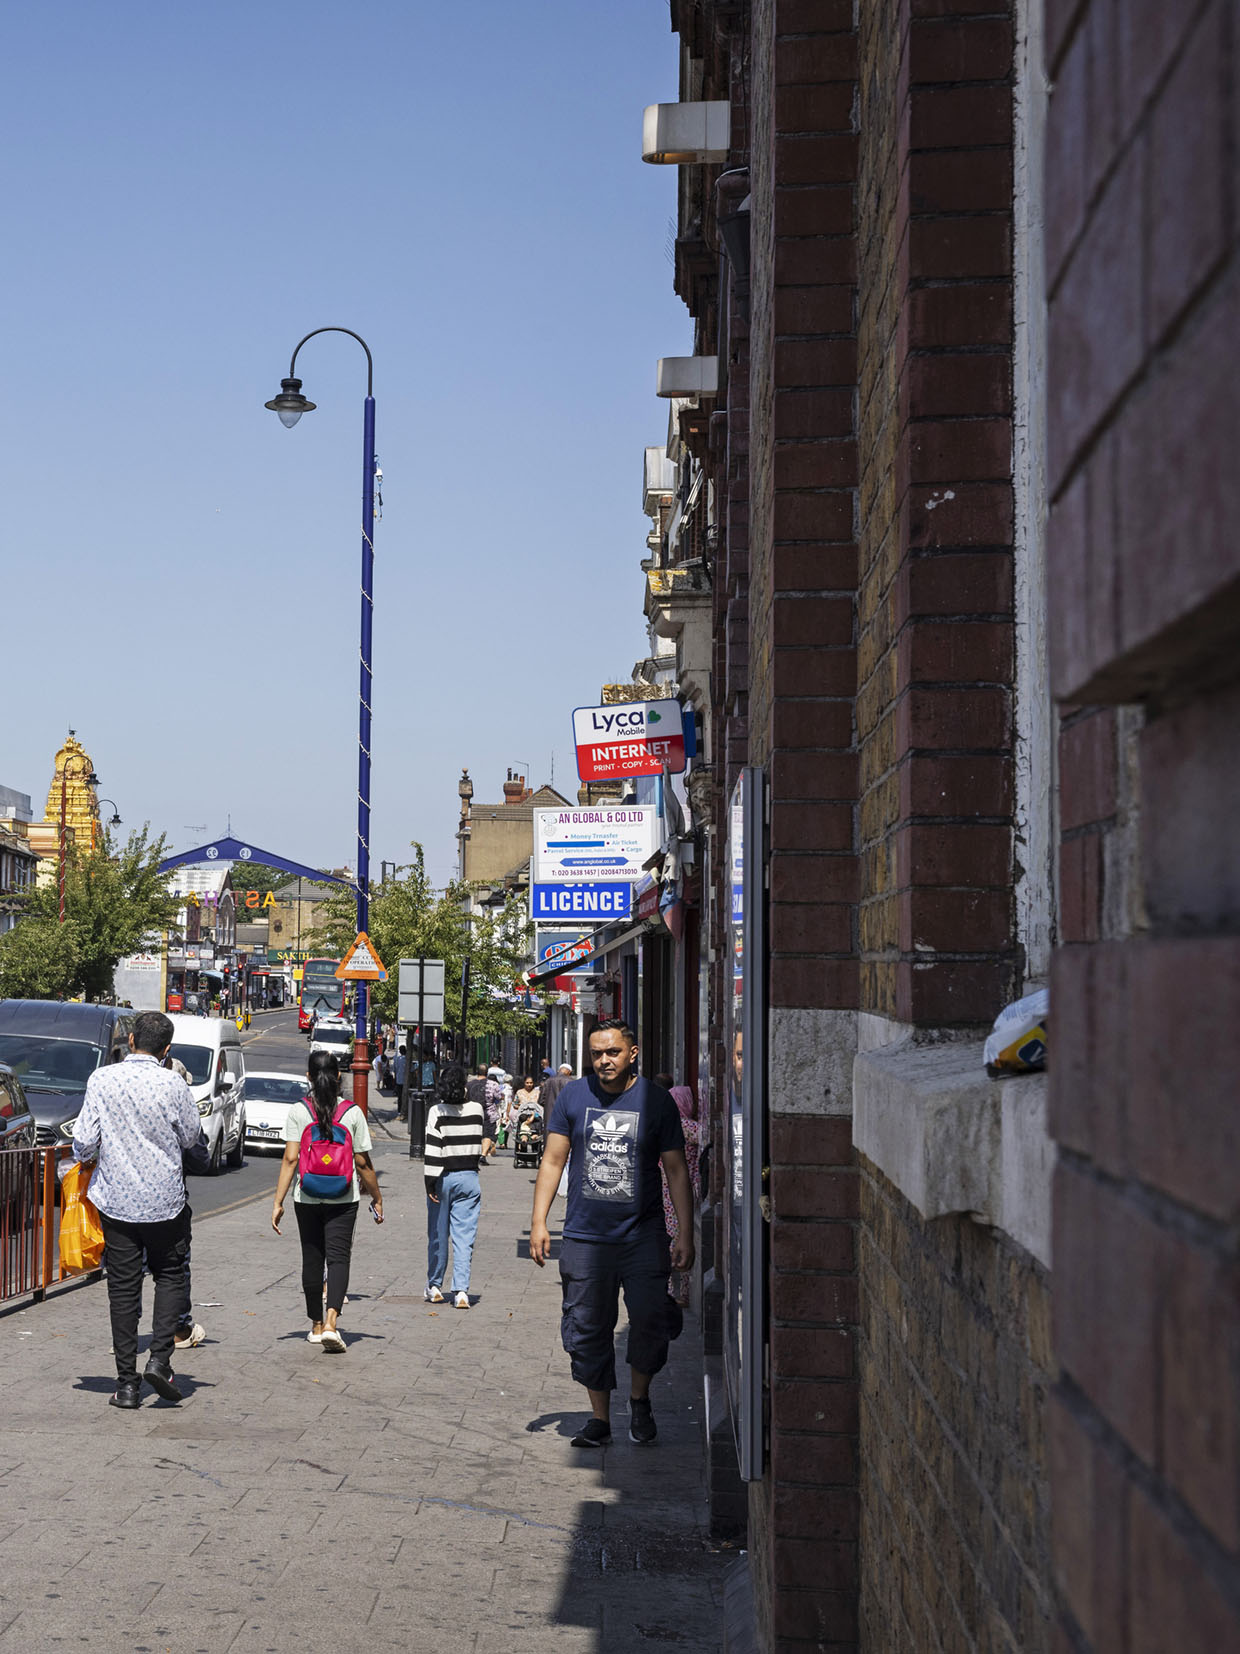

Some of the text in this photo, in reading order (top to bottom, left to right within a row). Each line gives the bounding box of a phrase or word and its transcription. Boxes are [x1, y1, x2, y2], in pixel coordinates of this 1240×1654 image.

[592, 711, 645, 732] Lyca
[617, 727, 645, 736] Mobile
[592, 740, 671, 761] INTERNET
[593, 763, 615, 772] PRINT
[622, 760, 643, 769] COPY
[650, 758, 671, 766] SCAN
[559, 811, 643, 824] AN GLOBAL & CO LTD
[540, 892, 624, 911] LICENCE
[590, 1141, 628, 1153] adidas
